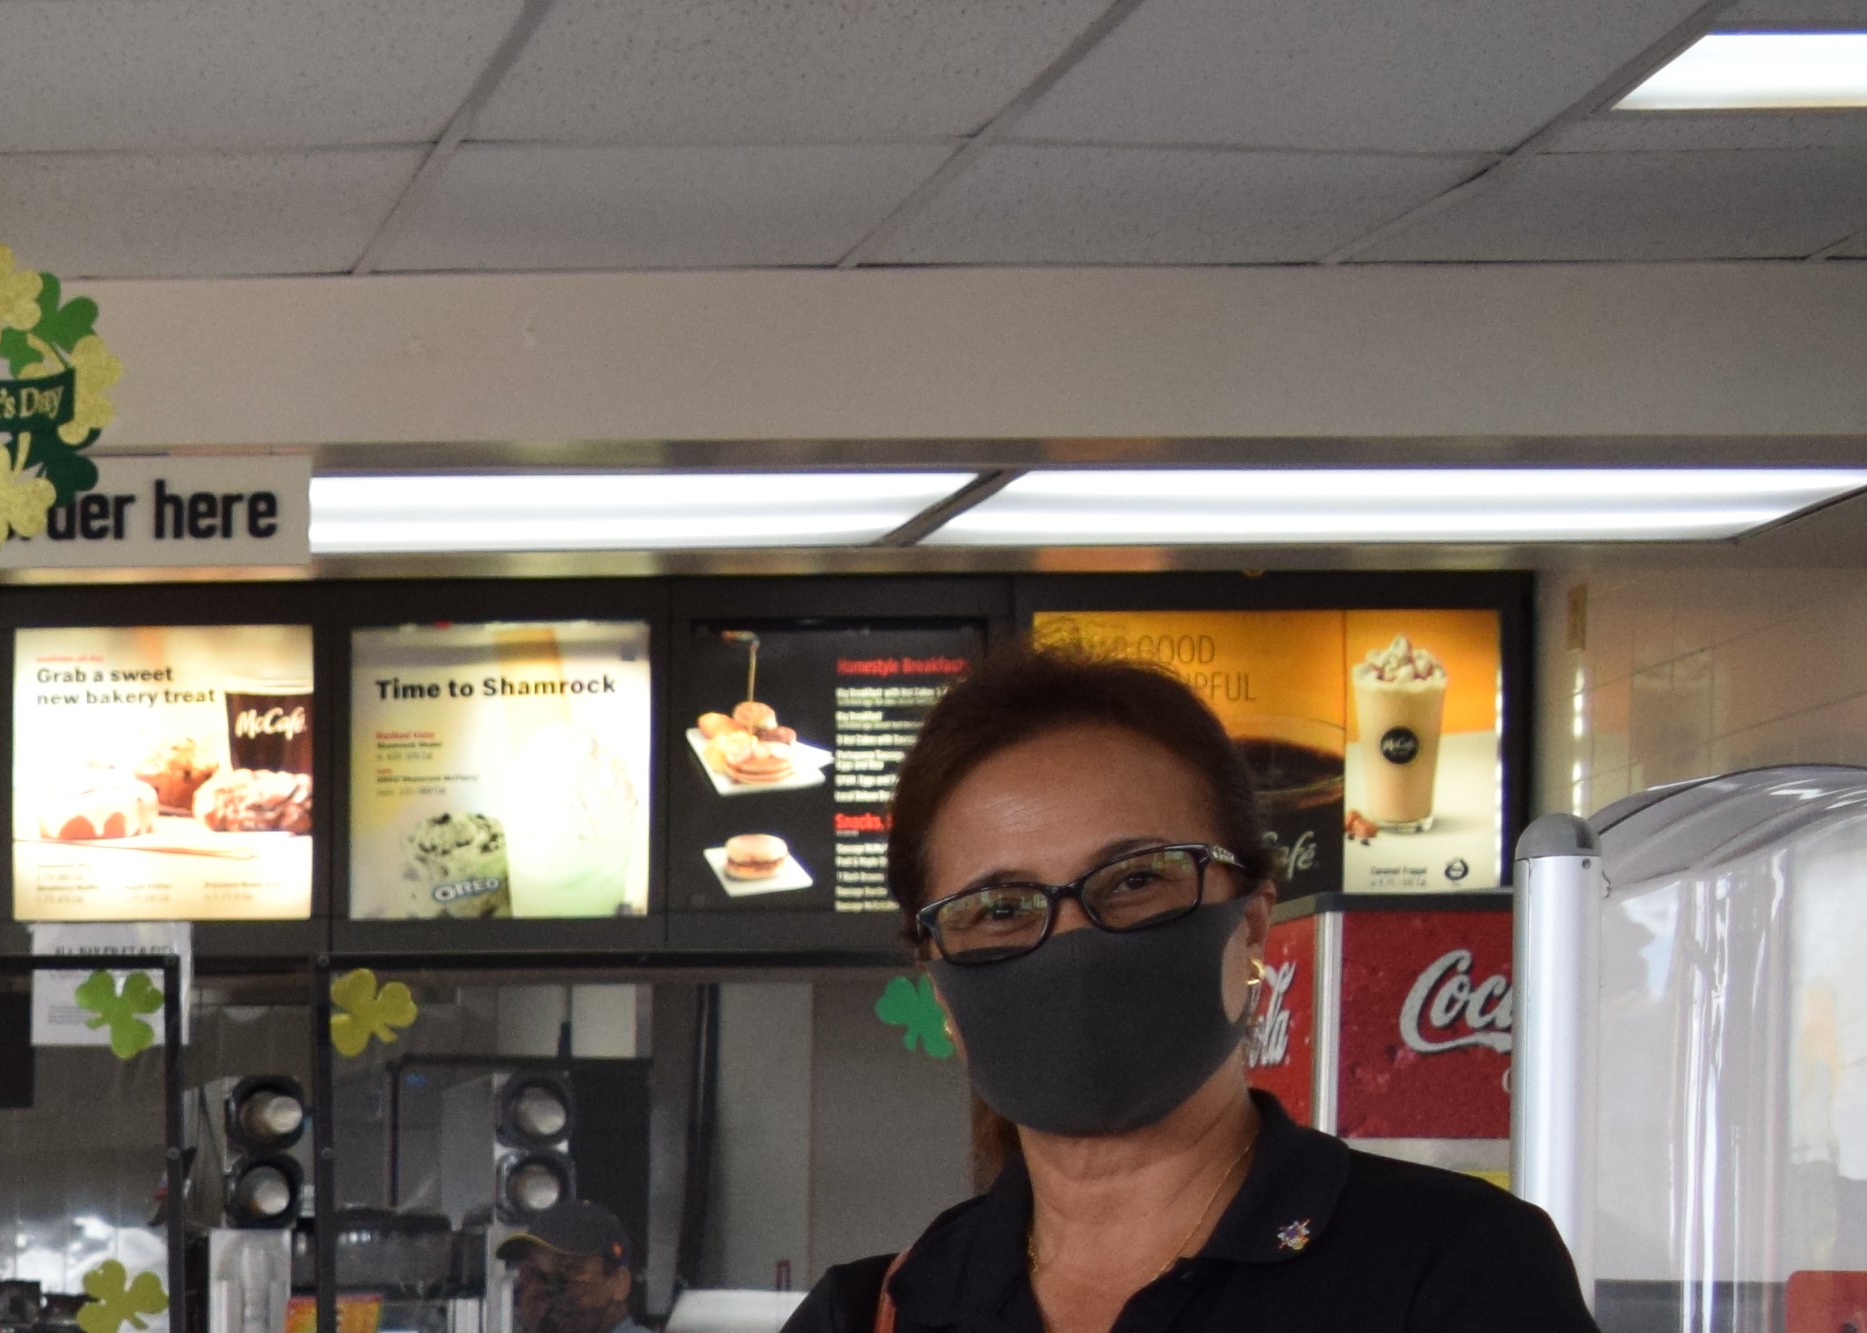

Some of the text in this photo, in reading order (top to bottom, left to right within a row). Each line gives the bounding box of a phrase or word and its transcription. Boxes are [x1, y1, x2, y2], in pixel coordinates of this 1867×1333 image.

[19, 385, 65, 420] Day
[154, 478, 278, 540] here
[36, 666, 173, 684] Grab a sweet
[36, 688, 216, 708] new bakery treat
[375, 674, 616, 701] Time to Shamrock
[433, 879, 500, 901] OREO
